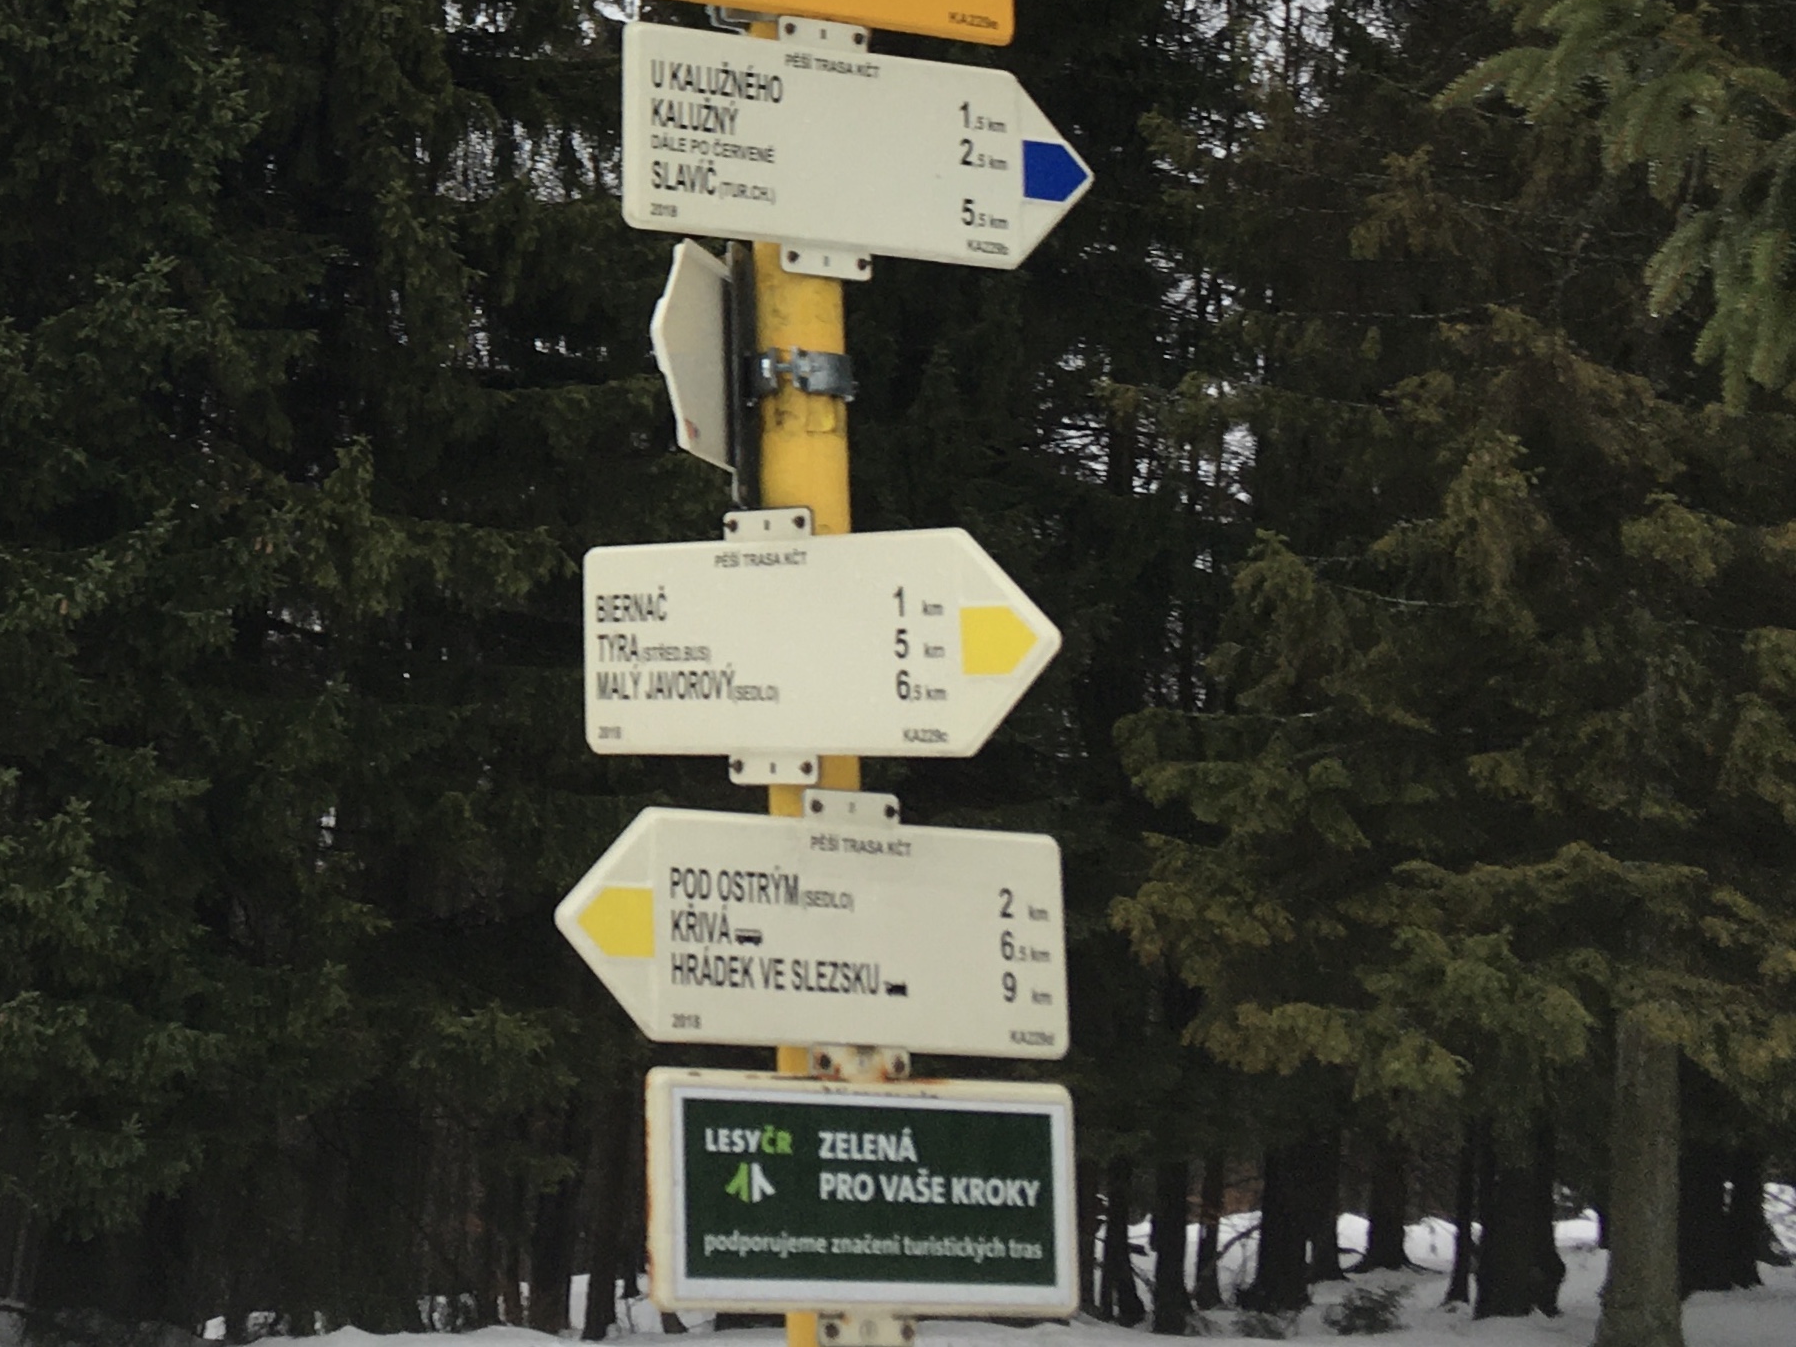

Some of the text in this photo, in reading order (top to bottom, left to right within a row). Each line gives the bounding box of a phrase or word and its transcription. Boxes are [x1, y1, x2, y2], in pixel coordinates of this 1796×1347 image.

[650, 59, 784, 104] U KALUŽNÉHO
[814, 57, 853, 75] TRASA
[650, 97, 739, 136] KALUŽNÝ
[987, 116, 1008, 133] km
[650, 132, 776, 164] DÁLE PO ČERVENÉ
[988, 155, 1008, 171] km
[650, 158, 717, 196] SLAVÍČ
[989, 214, 1009, 230] km
[742, 552, 781, 566] TRASA
[596, 585, 668, 623] BIERNAČ
[893, 585, 944, 618] 1 km
[893, 627, 946, 660] 5 km
[596, 664, 642, 700] MALÝ
[925, 686, 947, 701] km
[841, 838, 884, 854] TRASA
[670, 866, 712, 901] POD
[717, 865, 799, 906] OSTRÝM
[999, 887, 1050, 922] 2 km
[670, 904, 732, 944] KŘIVÁ
[670, 946, 880, 995] HRÁDEK VE SLEZSKU
[1030, 947, 1051, 964] km
[1002, 971, 1052, 1005] 9 km
[818, 1127, 918, 1163] ZELENÁ
[819, 1168, 1040, 1207] PRO VAŠE KROKY
[704, 1230, 1044, 1264] podporujeme značení turistických tras
